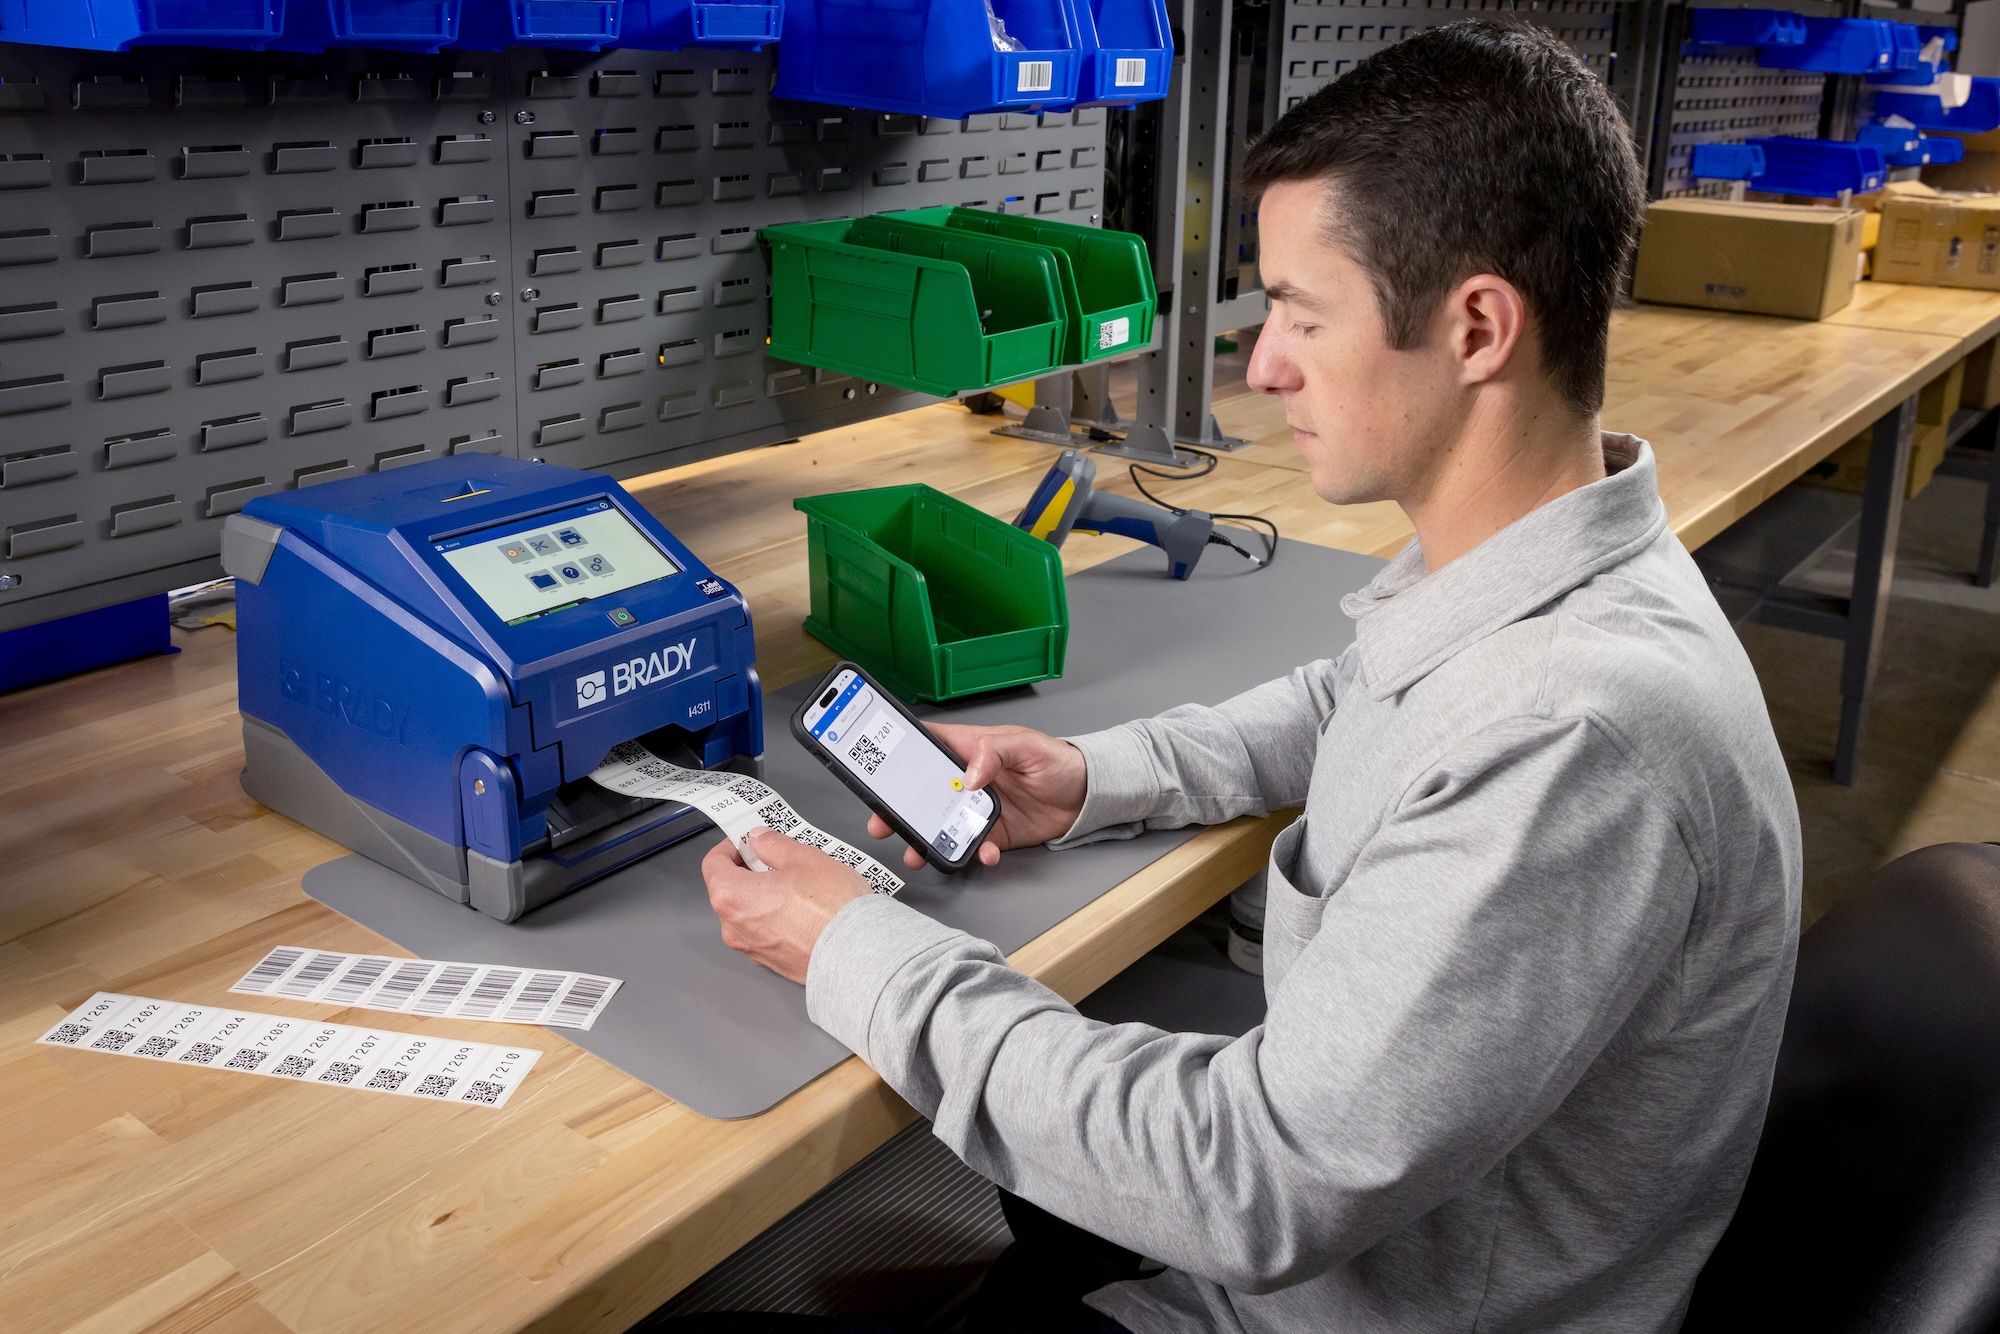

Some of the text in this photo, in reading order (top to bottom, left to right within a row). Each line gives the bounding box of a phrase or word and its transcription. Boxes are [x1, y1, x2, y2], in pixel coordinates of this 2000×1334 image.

[612, 637, 697, 697] BRADY
[688, 700, 711, 718] i4311
[873, 721, 894, 743] 7201
[618, 775, 646, 788] 7208
[711, 797, 739, 812] 7205
[79, 999, 116, 1022] 7201
[124, 1004, 161, 1029] 7202
[167, 1010, 202, 1035] 7203
[211, 1016, 246, 1042] 7204
[256, 1022, 290, 1048] 7205
[303, 1029, 336, 1055] 7206
[348, 1035, 381, 1061] 7207
[394, 1041, 427, 1068] 7208
[442, 1047, 474, 1073] 7209
[489, 1052, 520, 1079] 7210
